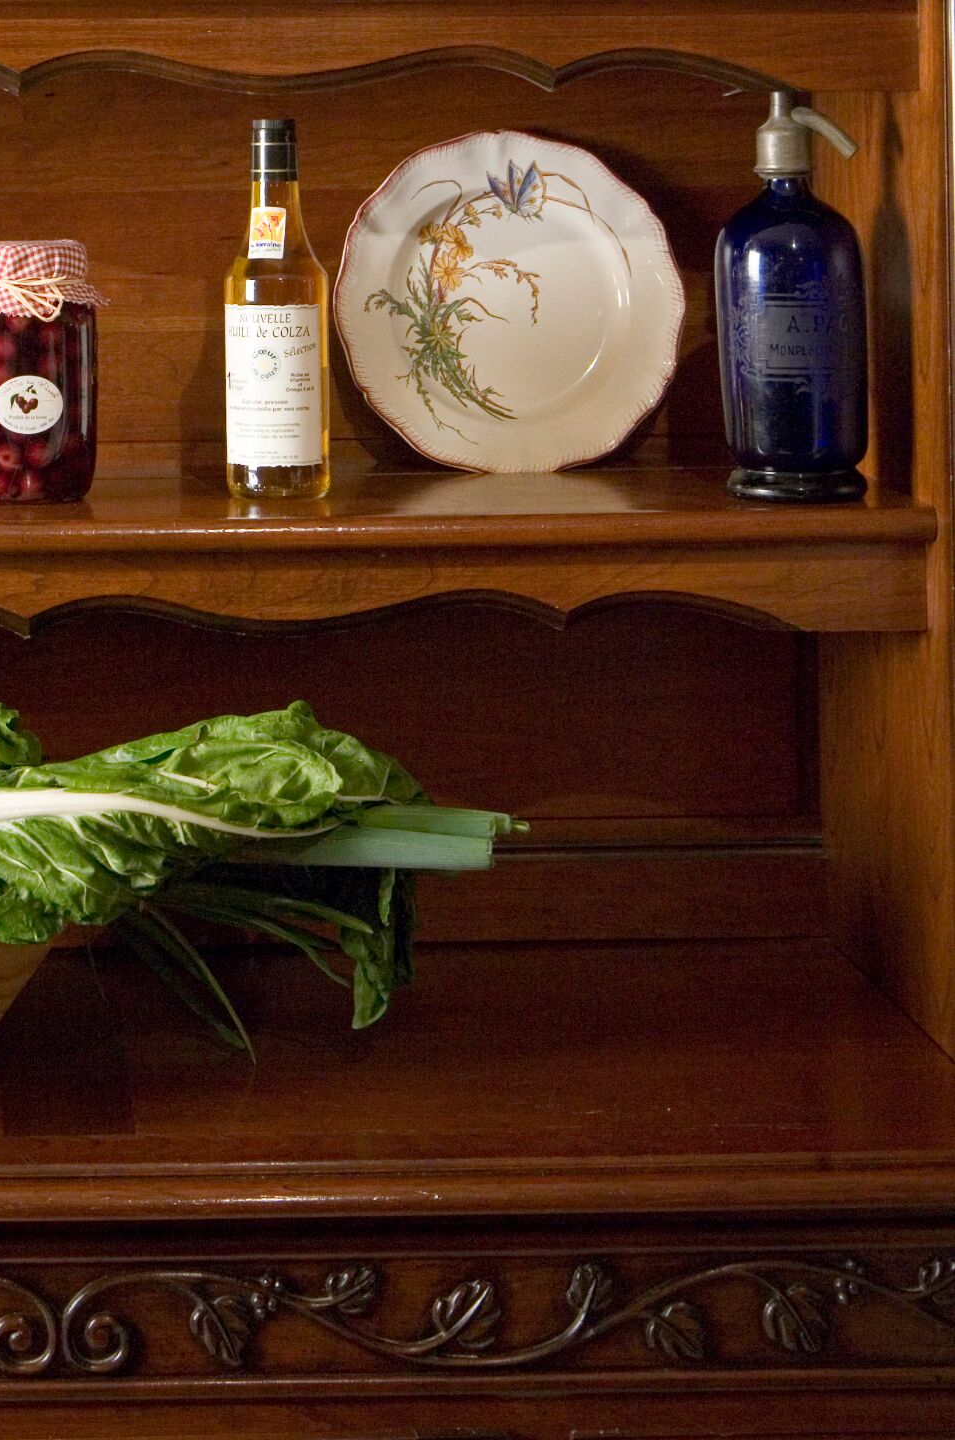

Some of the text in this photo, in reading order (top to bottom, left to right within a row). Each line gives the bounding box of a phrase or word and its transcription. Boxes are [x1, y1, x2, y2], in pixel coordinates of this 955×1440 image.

[239, 313, 291, 324] NOUVELLE
[228, 325, 311, 338] HUILE de COLZA
